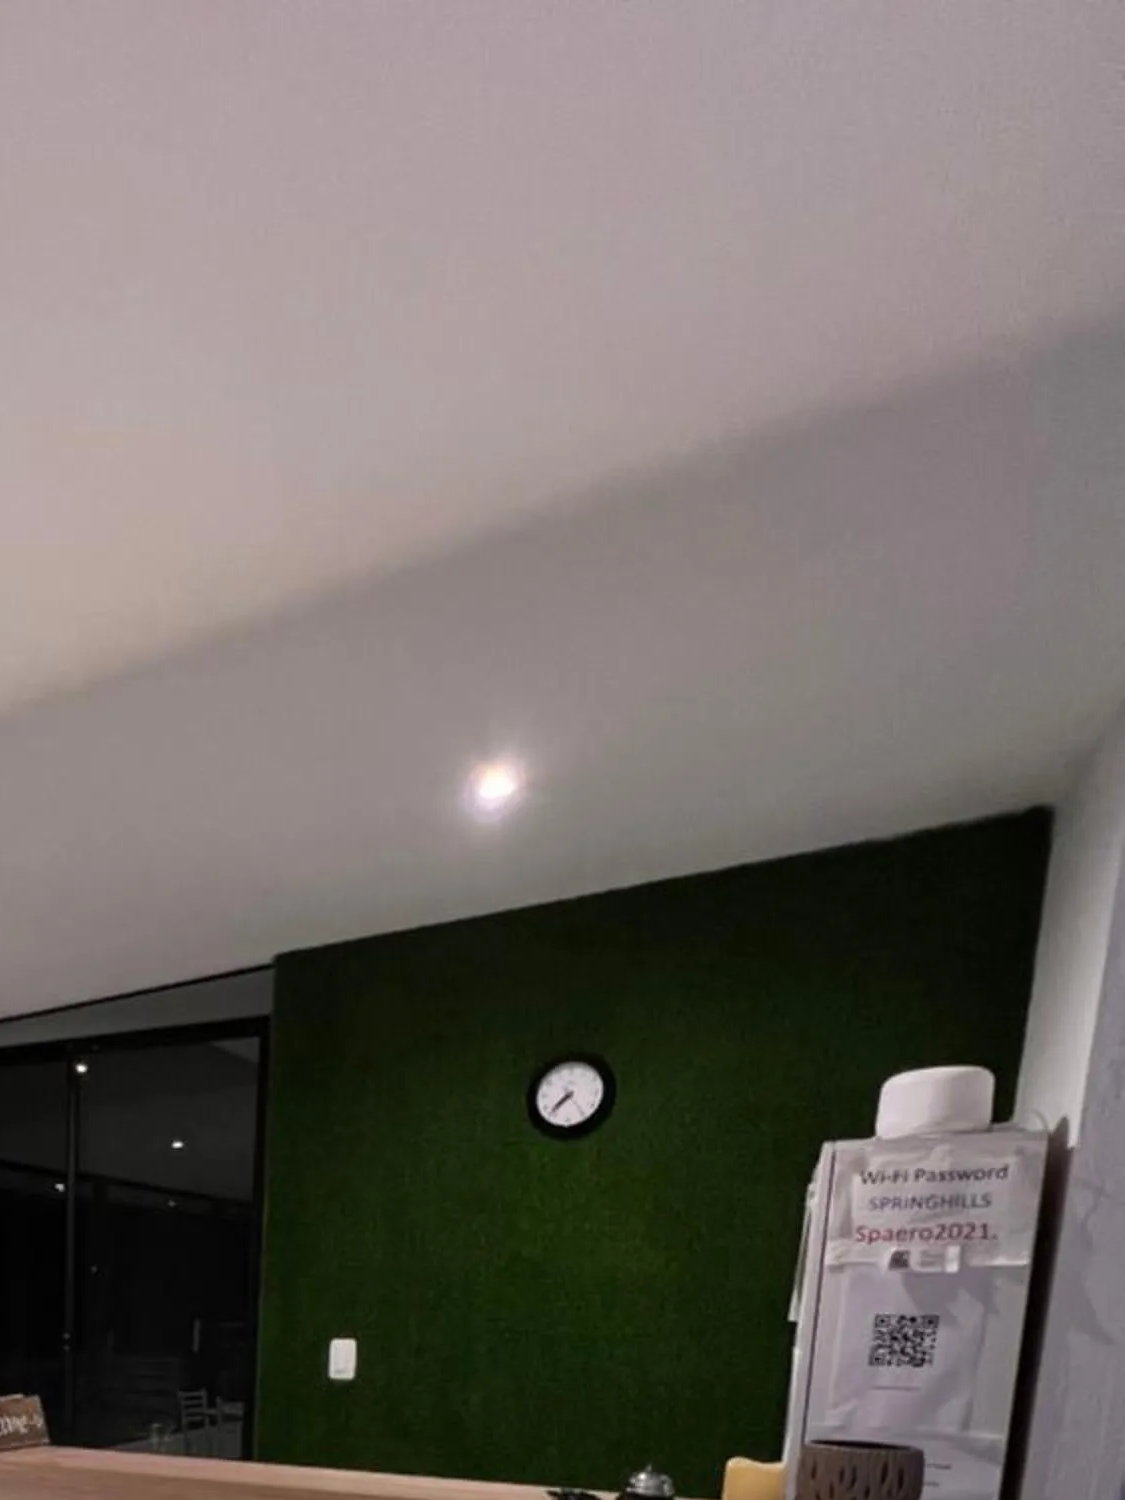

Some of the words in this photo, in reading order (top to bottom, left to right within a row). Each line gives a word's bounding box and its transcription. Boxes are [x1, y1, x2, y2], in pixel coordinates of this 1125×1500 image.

[859, 1169, 908, 1185] Wi-Fi
[914, 1164, 1009, 1183] Password
[869, 1192, 992, 1210] SPRINGHILLS
